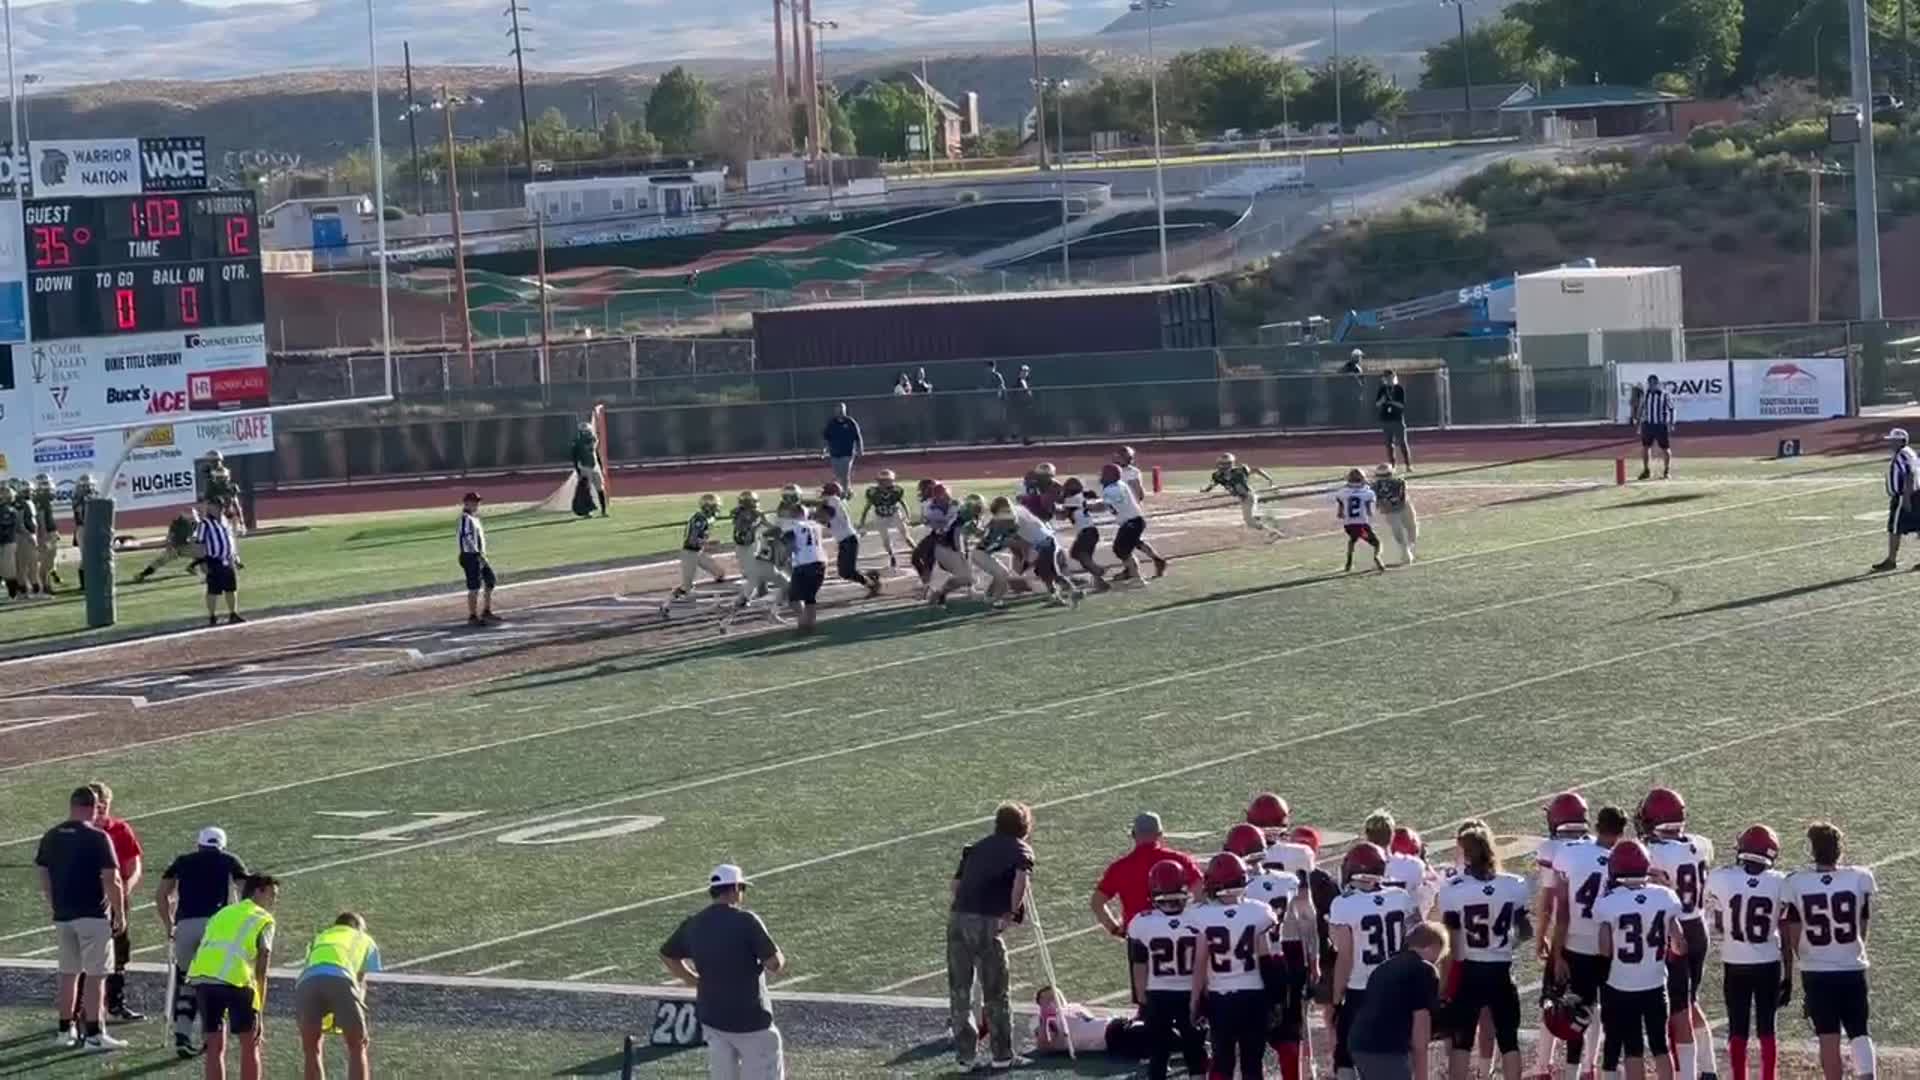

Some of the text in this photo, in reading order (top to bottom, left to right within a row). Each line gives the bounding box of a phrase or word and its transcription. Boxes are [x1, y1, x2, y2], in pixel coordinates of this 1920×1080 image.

[73, 148, 132, 164] WARRIOR
[142, 150, 205, 179] WADE
[82, 170, 129, 186] NATION
[26, 206, 71, 224] GUEST
[131, 200, 181, 238] 1:03
[34, 226, 70, 267] 35
[128, 241, 160, 258] TIME
[227, 216, 250, 254] 12
[36, 275, 73, 292] DOWN
[96, 272, 134, 288] TO GO
[153, 267, 205, 285] BALL ON
[222, 264, 250, 281] QTR.
[116, 290, 136, 329] 0
[181, 287, 198, 323] 0
[126, 354, 146, 369] TITLE
[146, 351, 183, 369] COMPANY
[145, 391, 187, 415] ACE
[236, 415, 269, 441] CAFE
[132, 471, 193, 493] HUGHES
[1350, 496, 1361, 518] 2
[1575, 871, 1602, 919] 4
[1677, 862, 1705, 913] 8
[1464, 902, 1514, 949] 54
[1617, 910, 1667, 964] 34
[1729, 894, 1774, 944] 16
[1800, 890, 1858, 948] 59
[1205, 924, 1257, 973] 24
[1361, 910, 1406, 965] 30
[1150, 936, 1197, 977] 20
[652, 1003, 697, 1044] 20
